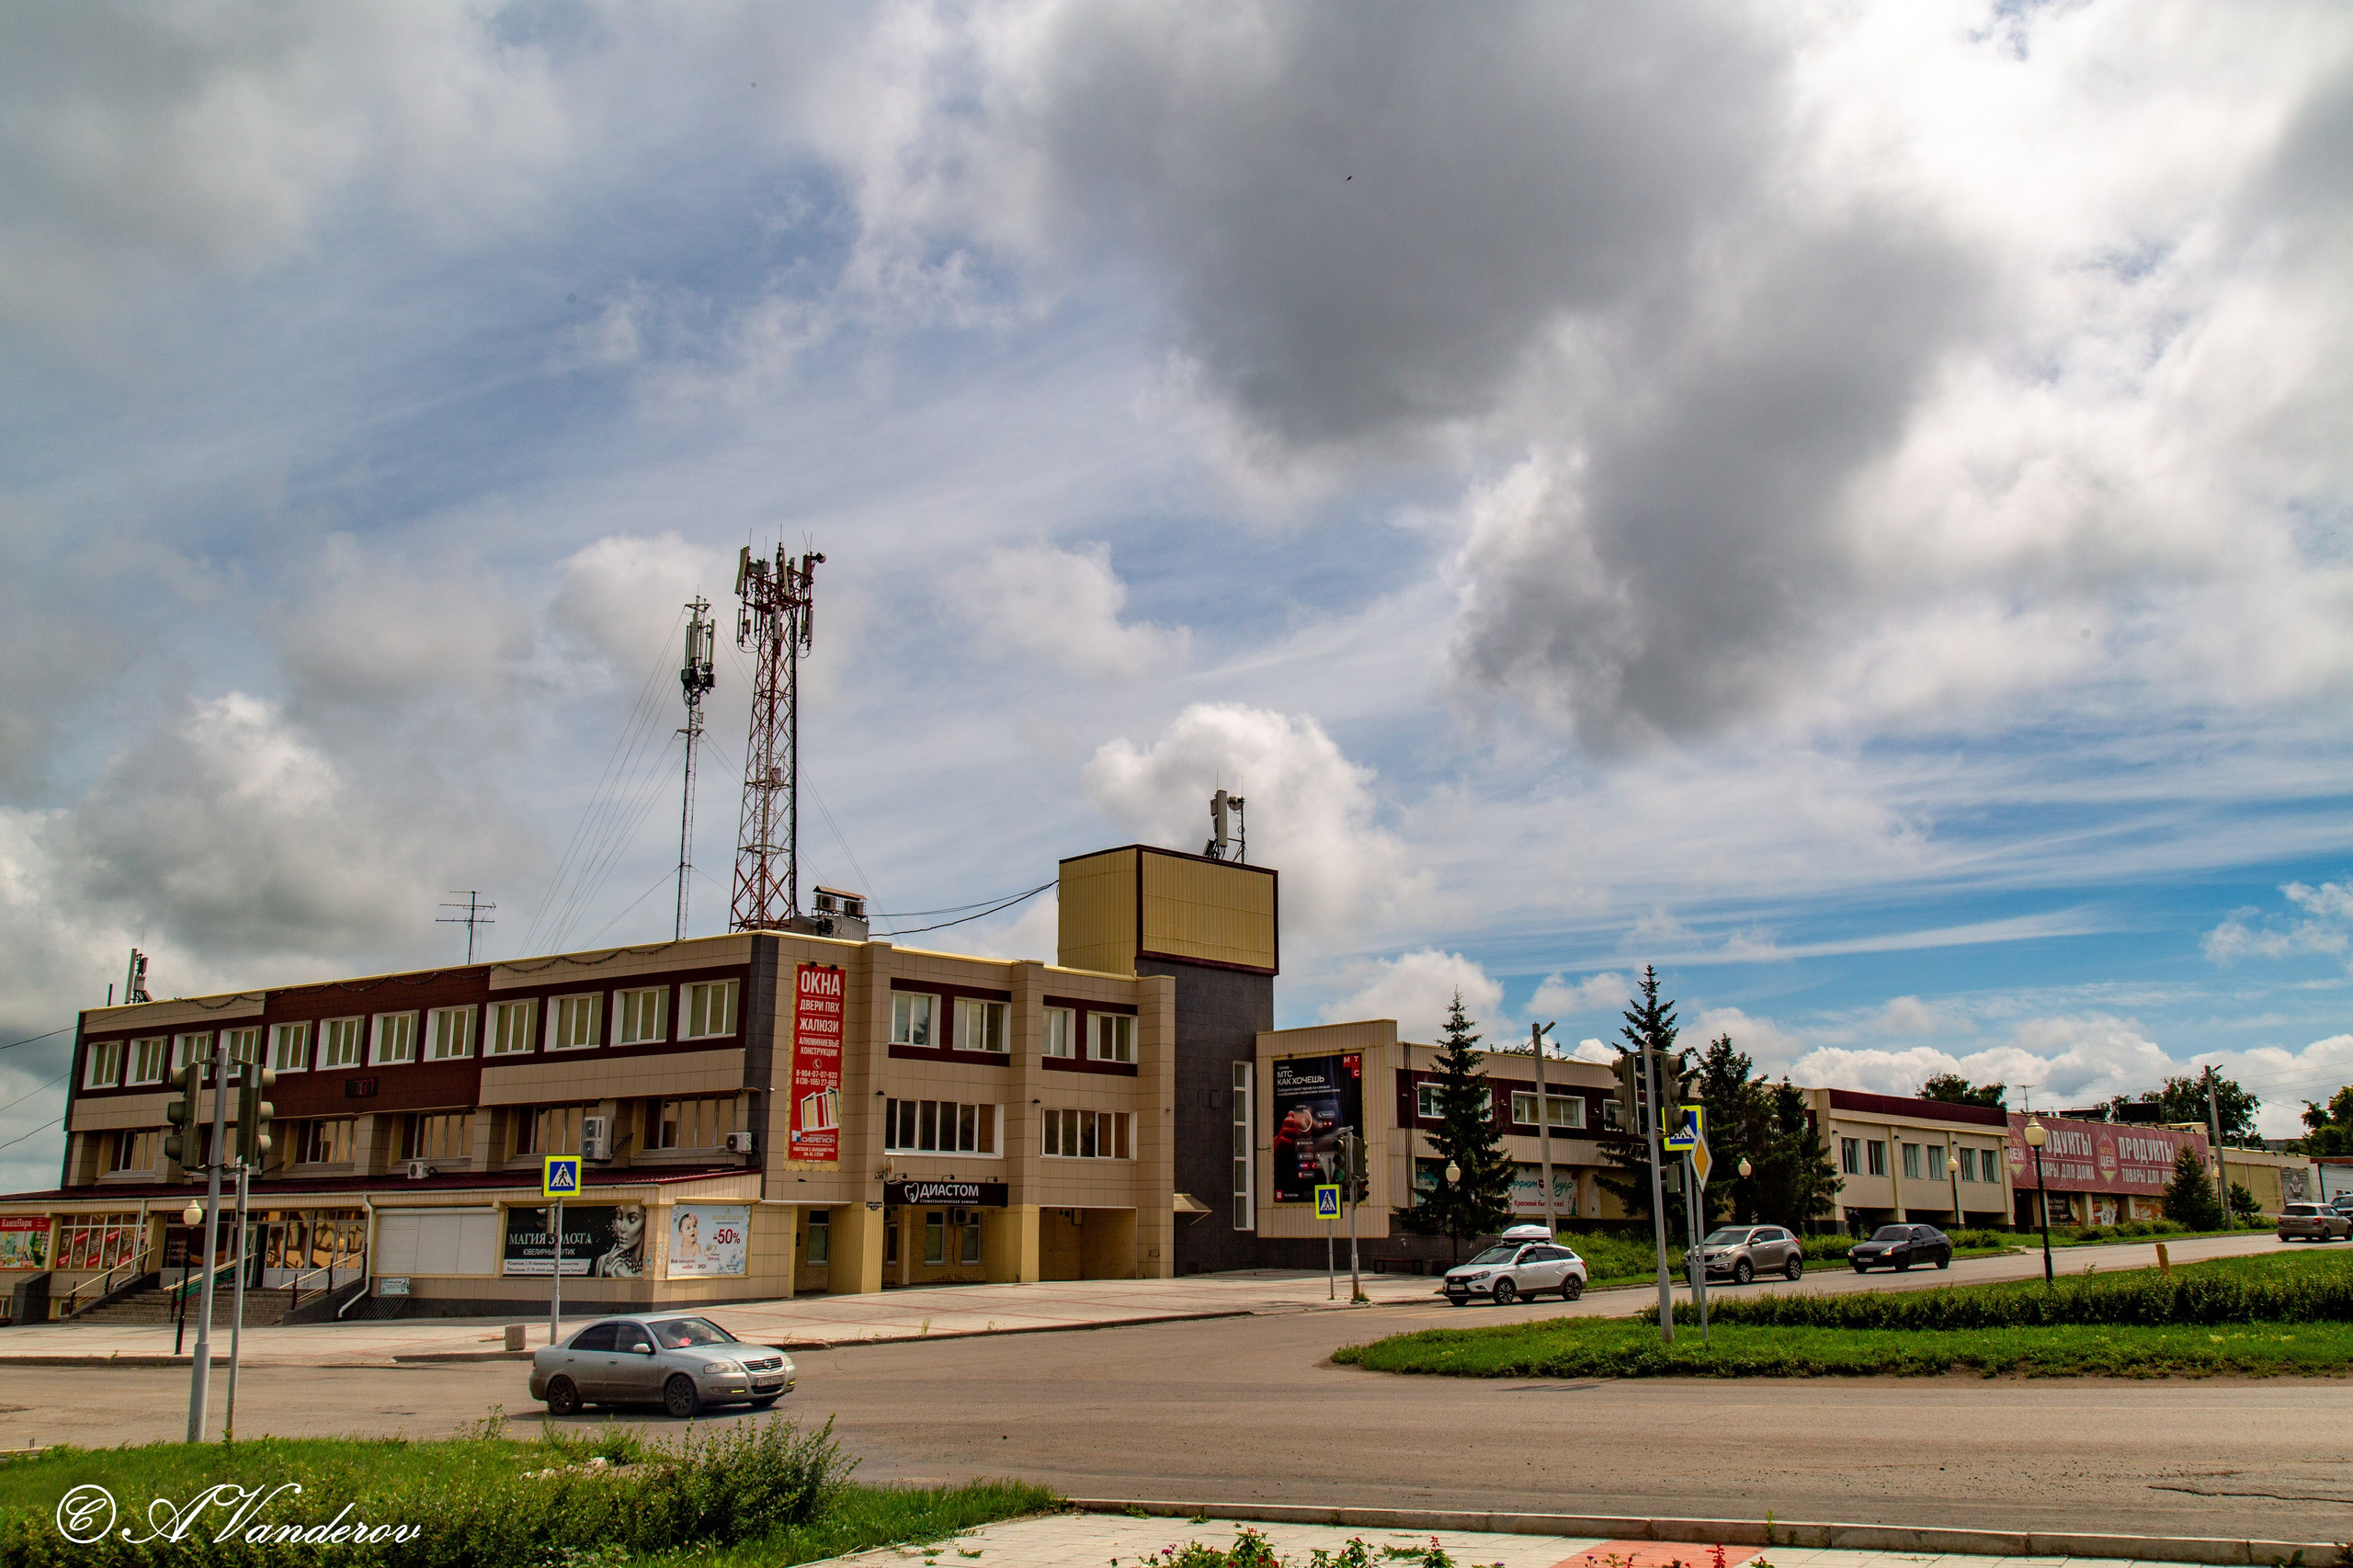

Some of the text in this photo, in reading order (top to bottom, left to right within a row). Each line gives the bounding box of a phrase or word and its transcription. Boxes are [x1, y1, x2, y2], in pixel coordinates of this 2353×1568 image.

[801, 971, 841, 996] ОКНА
[800, 999, 840, 1014] ДВЕРИ ПВХ
[799, 1017, 839, 1034] ЖАЛЮЗИ
[798, 1036, 840, 1048] АЛЮМИНИЕВЫЕ
[800, 1046, 838, 1058] КОНСТРУКЦИИ
[795, 1069, 838, 1080] 8-904-07-07-933
[1277, 1070, 1293, 1079] МТС
[1277, 1075, 1325, 1086] КАК ХОЧЕШЬ
[801, 1136, 835, 1144] СИБРЕГИОН
[2030, 1129, 2093, 1158] ОДУКТЫ
[2098, 1146, 2114, 1156] НИЗКО
[2118, 1136, 2176, 1165] ПРОДУКТЫ
[2099, 1154, 2115, 1169] ЦЕН
[2031, 1161, 2096, 1182] ТВАРЫ ДЛЯ ДОМА
[2121, 1167, 2146, 1183] ТОВАРЫ
[2147, 1169, 2160, 1185] ДЛЯ
[920, 1184, 980, 1199] ДИАСТОМ
[1513, 1199, 1537, 1209] Красивой
[1, 1218, 33, 1230] КанцПарк
[508, 1233, 547, 1245] МАГИЯ
[713, 1228, 741, 1244] -50%
